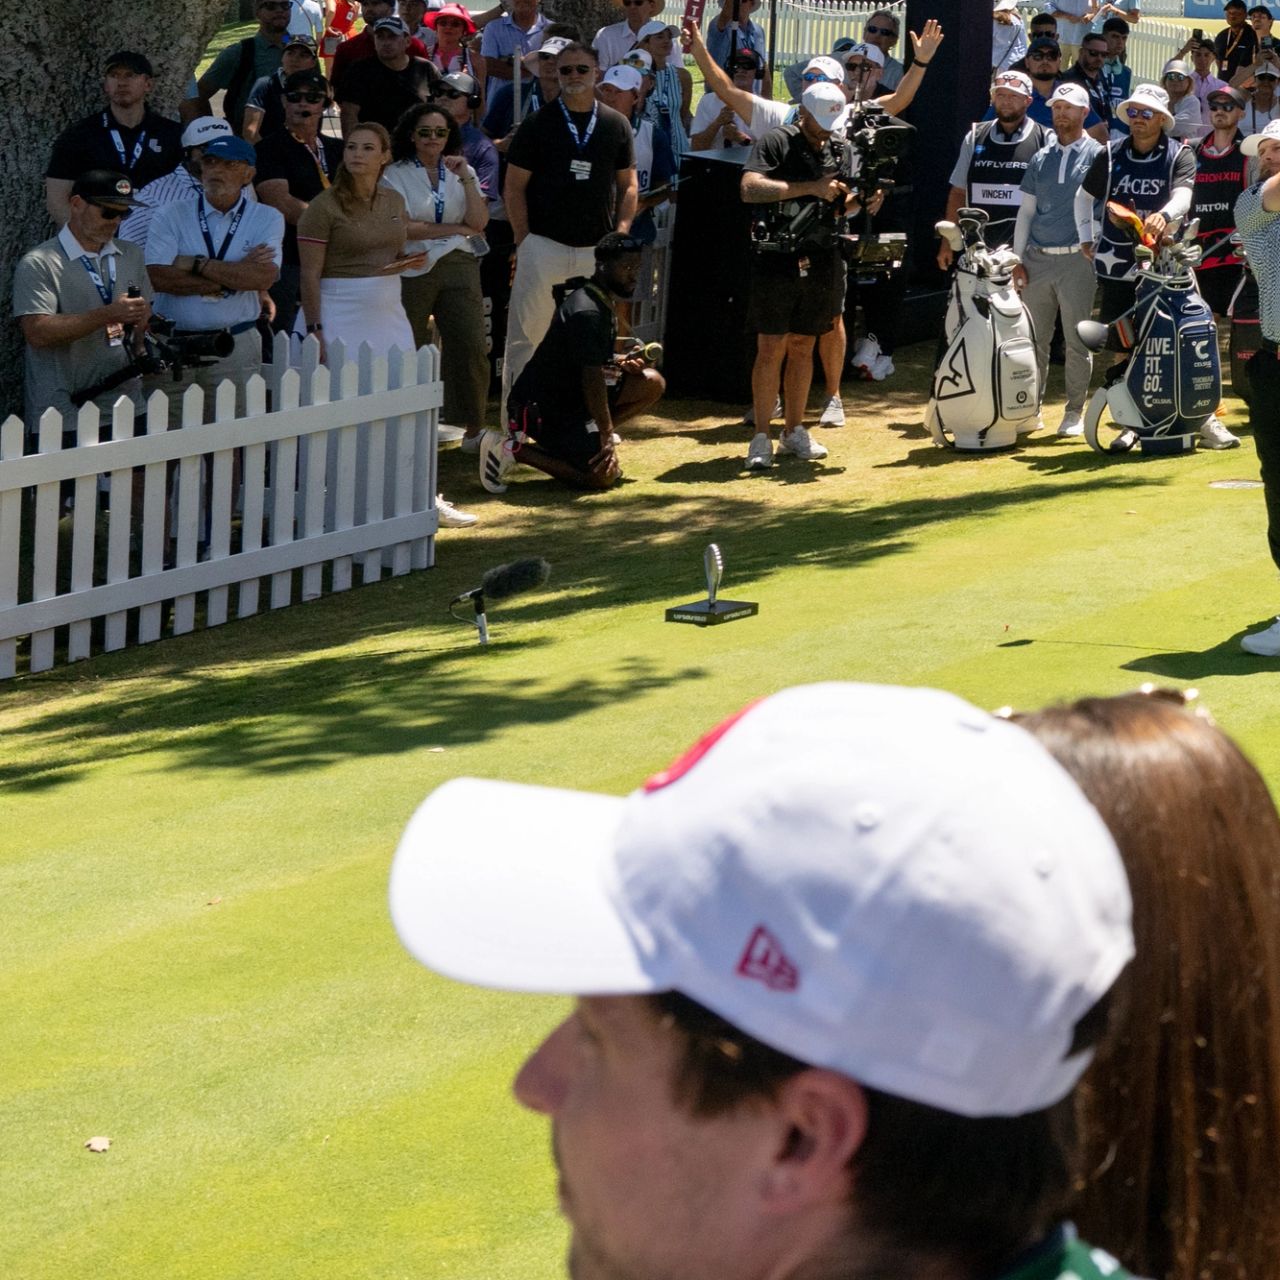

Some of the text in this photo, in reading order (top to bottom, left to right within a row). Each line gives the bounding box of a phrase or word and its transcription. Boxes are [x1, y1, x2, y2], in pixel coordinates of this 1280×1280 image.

[975, 160, 1028, 170] HYFLYERS
[981, 189, 1014, 200] VINCENT
[1145, 337, 1174, 355] LIVE.
[1144, 356, 1162, 374] FIT.
[1143, 375, 1163, 392] GO.
